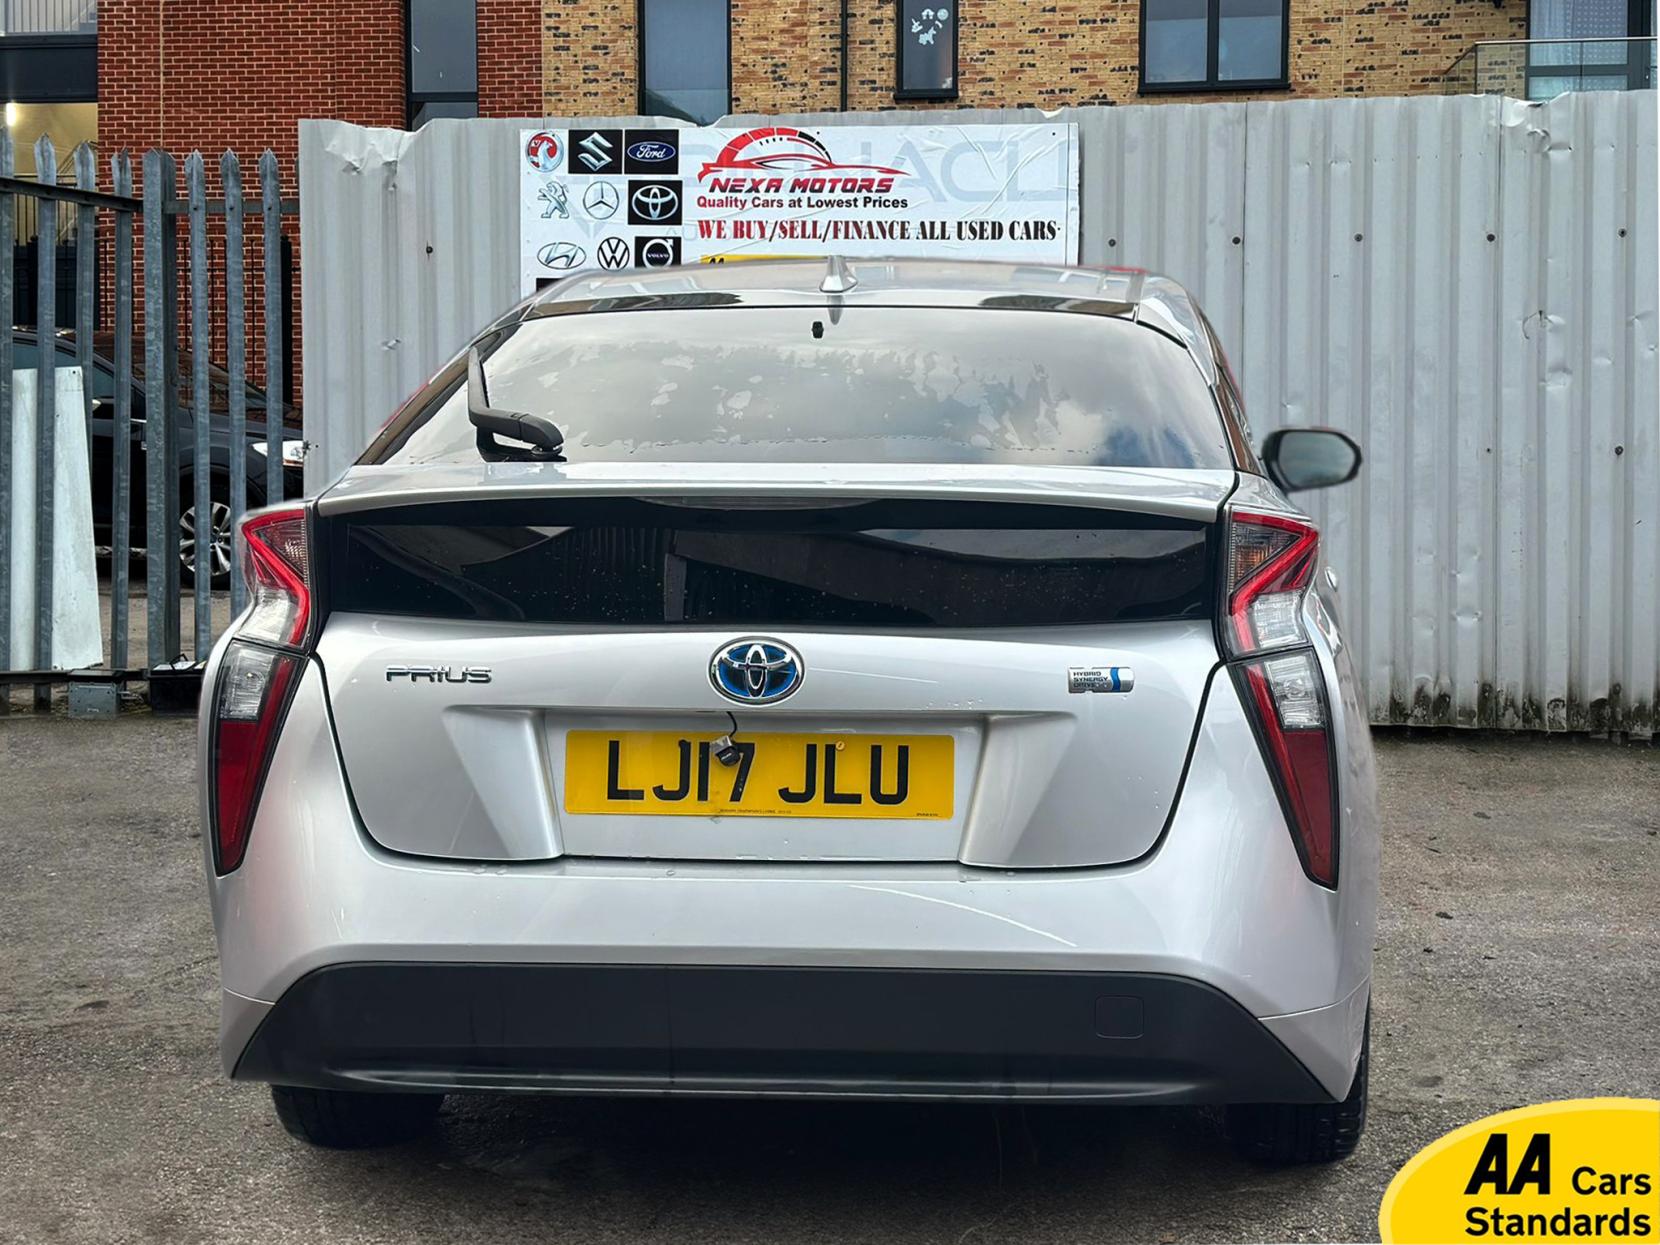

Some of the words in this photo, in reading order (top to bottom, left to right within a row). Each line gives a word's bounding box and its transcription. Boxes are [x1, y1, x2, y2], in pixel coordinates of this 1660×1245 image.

[636, 144, 666, 159] Ford
[708, 177, 784, 194] NEXA
[788, 177, 894, 194] MOTORS
[697, 196, 747, 210] Quality
[752, 196, 784, 208] Cars
[788, 197, 802, 208] at
[807, 196, 858, 208] Lowest
[863, 196, 908, 208] Prices
[697, 220, 727, 240] WE
[733, 219, 911, 243] BUY/SELL/FINANCE
[916, 220, 951, 240] ALL
[956, 220, 1004, 241] USED
[1008, 220, 1057, 241] CARS
[386, 664, 492, 684] PRIUS
[606, 739, 756, 803] LJ17
[777, 742, 911, 805] JLU
